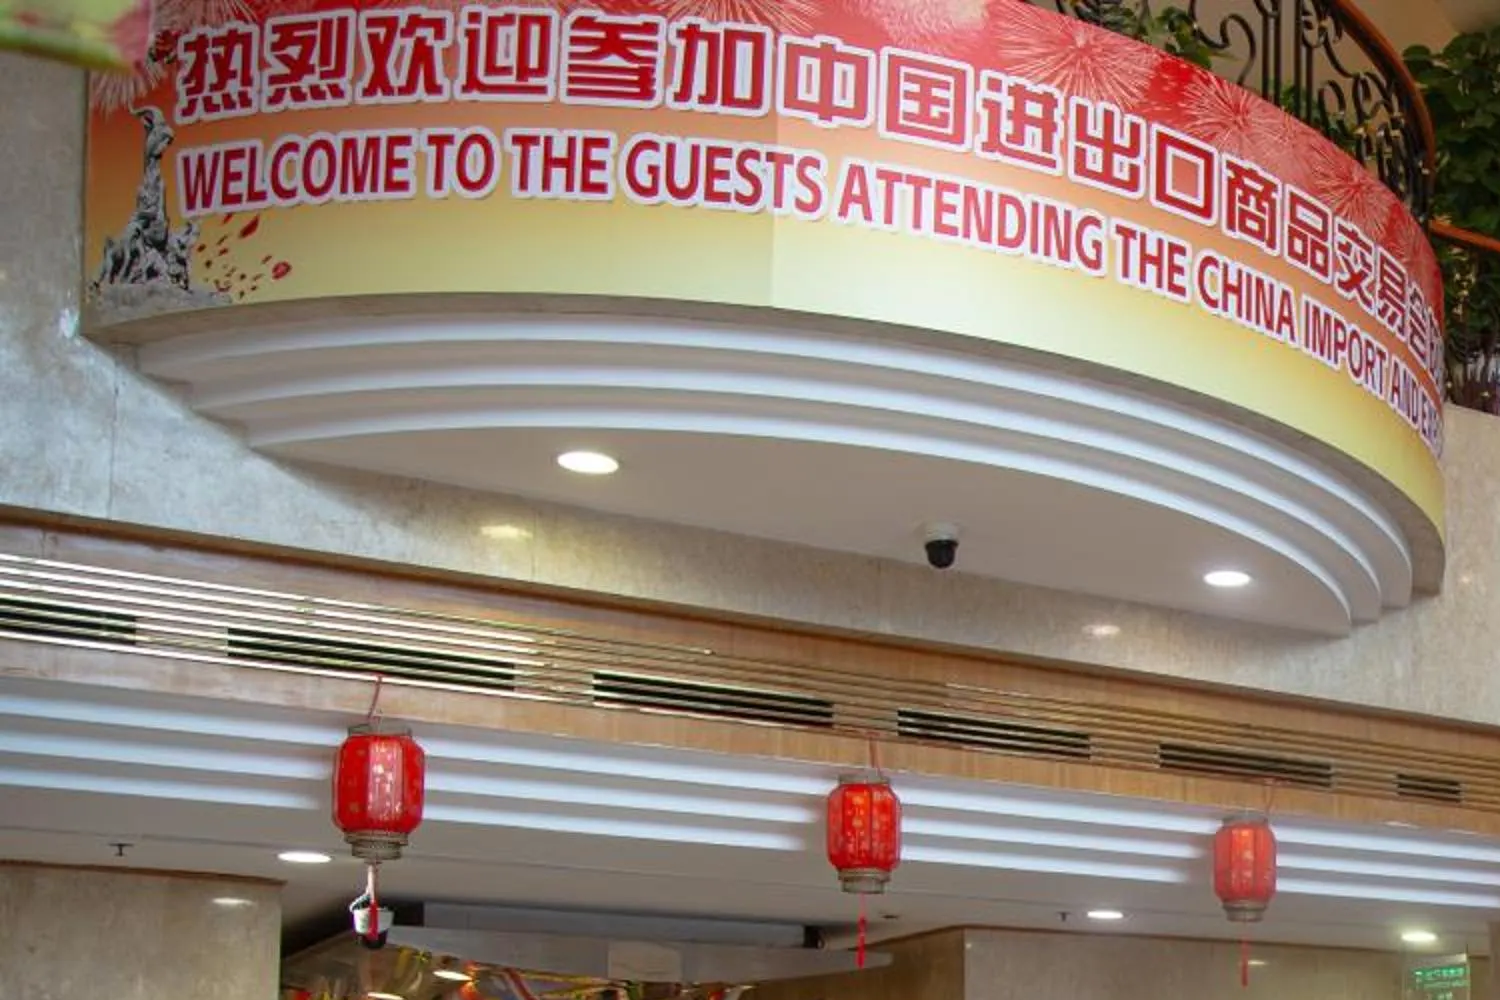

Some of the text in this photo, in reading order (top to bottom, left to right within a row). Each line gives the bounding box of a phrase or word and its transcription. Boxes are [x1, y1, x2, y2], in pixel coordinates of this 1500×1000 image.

[181, 134, 413, 212] WELCOME
[427, 133, 496, 192] TO
[511, 134, 610, 194] THE
[625, 139, 822, 214] GUESTS
[837, 165, 1104, 272] ATTENDING
[1114, 223, 1188, 298] THE
[1196, 255, 1296, 344] CHINA
[1303, 298, 1387, 397] IMPORT
